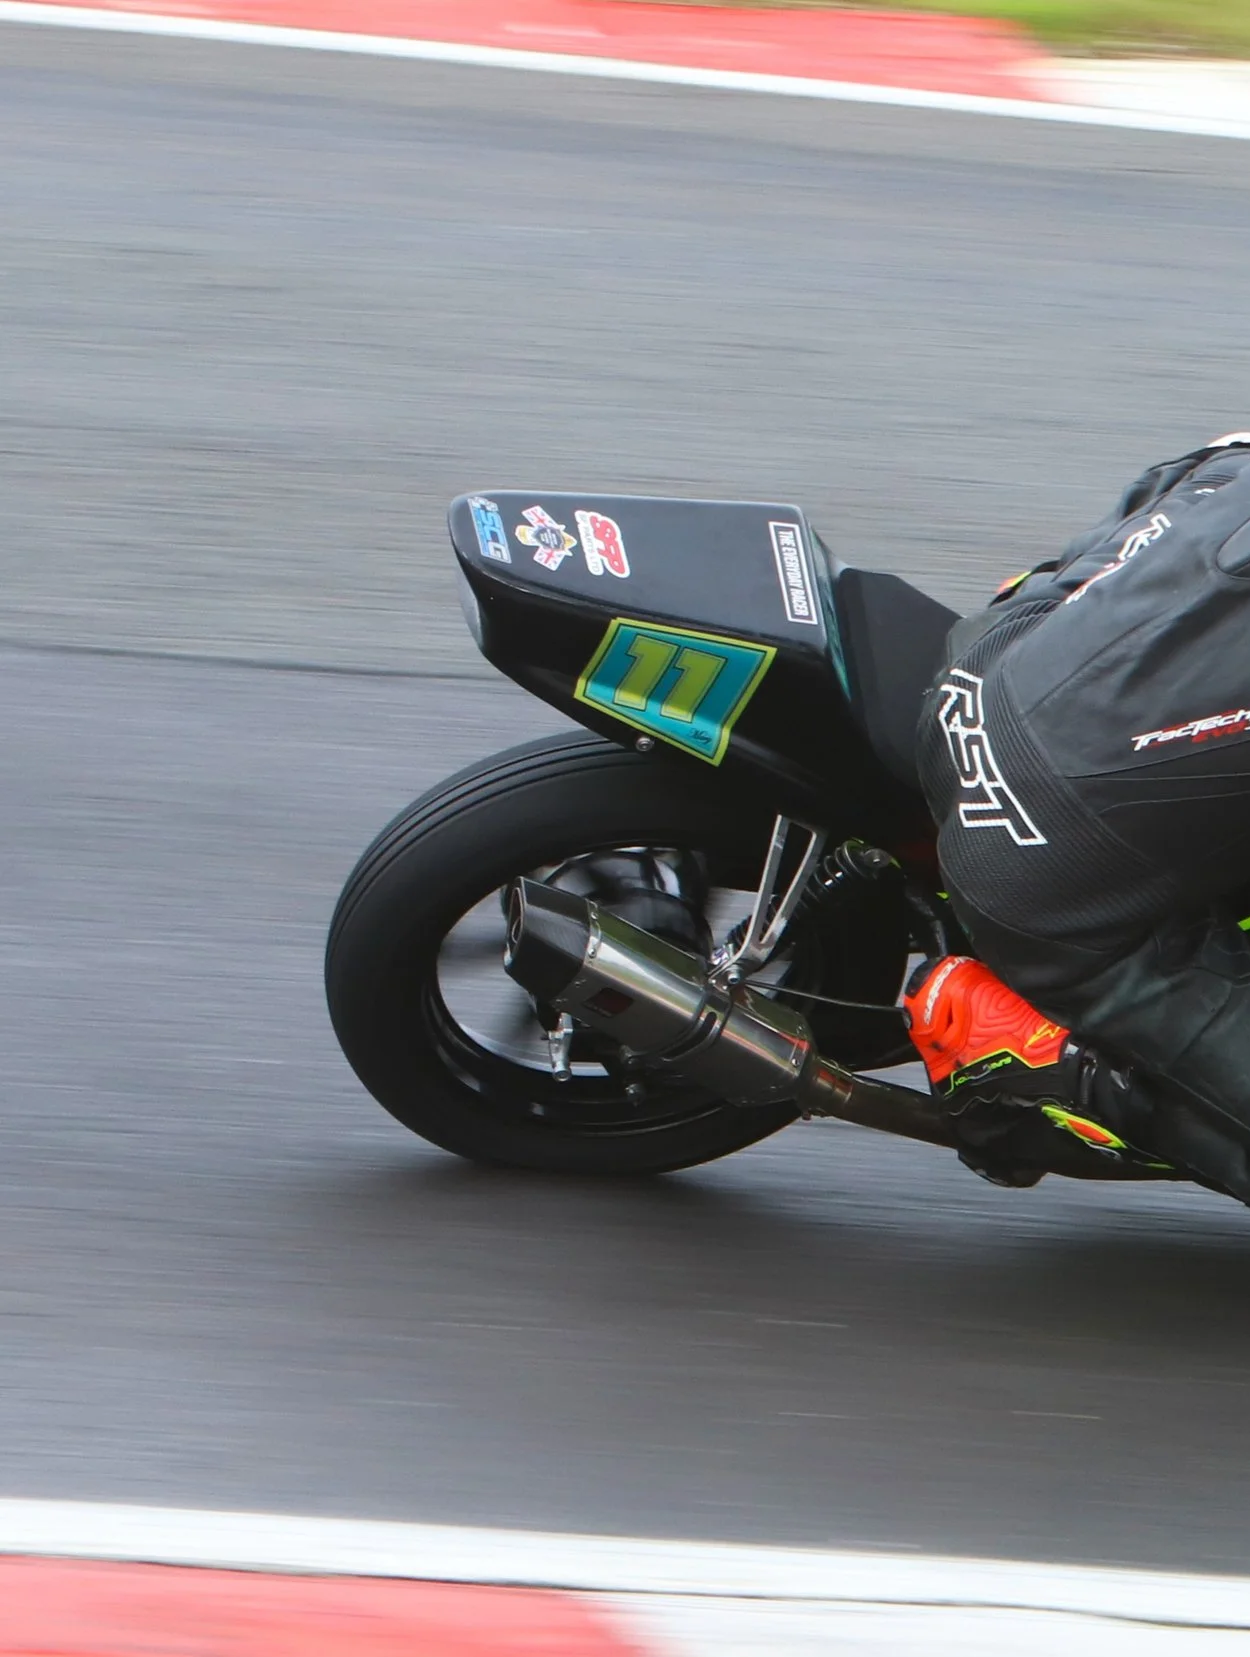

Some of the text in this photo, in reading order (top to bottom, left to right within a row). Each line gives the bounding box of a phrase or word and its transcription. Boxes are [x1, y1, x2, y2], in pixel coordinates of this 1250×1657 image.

[778, 531, 809, 616] THE EVERYDAY RACER
[613, 634, 727, 723] 11
[939, 668, 1048, 846] RST
